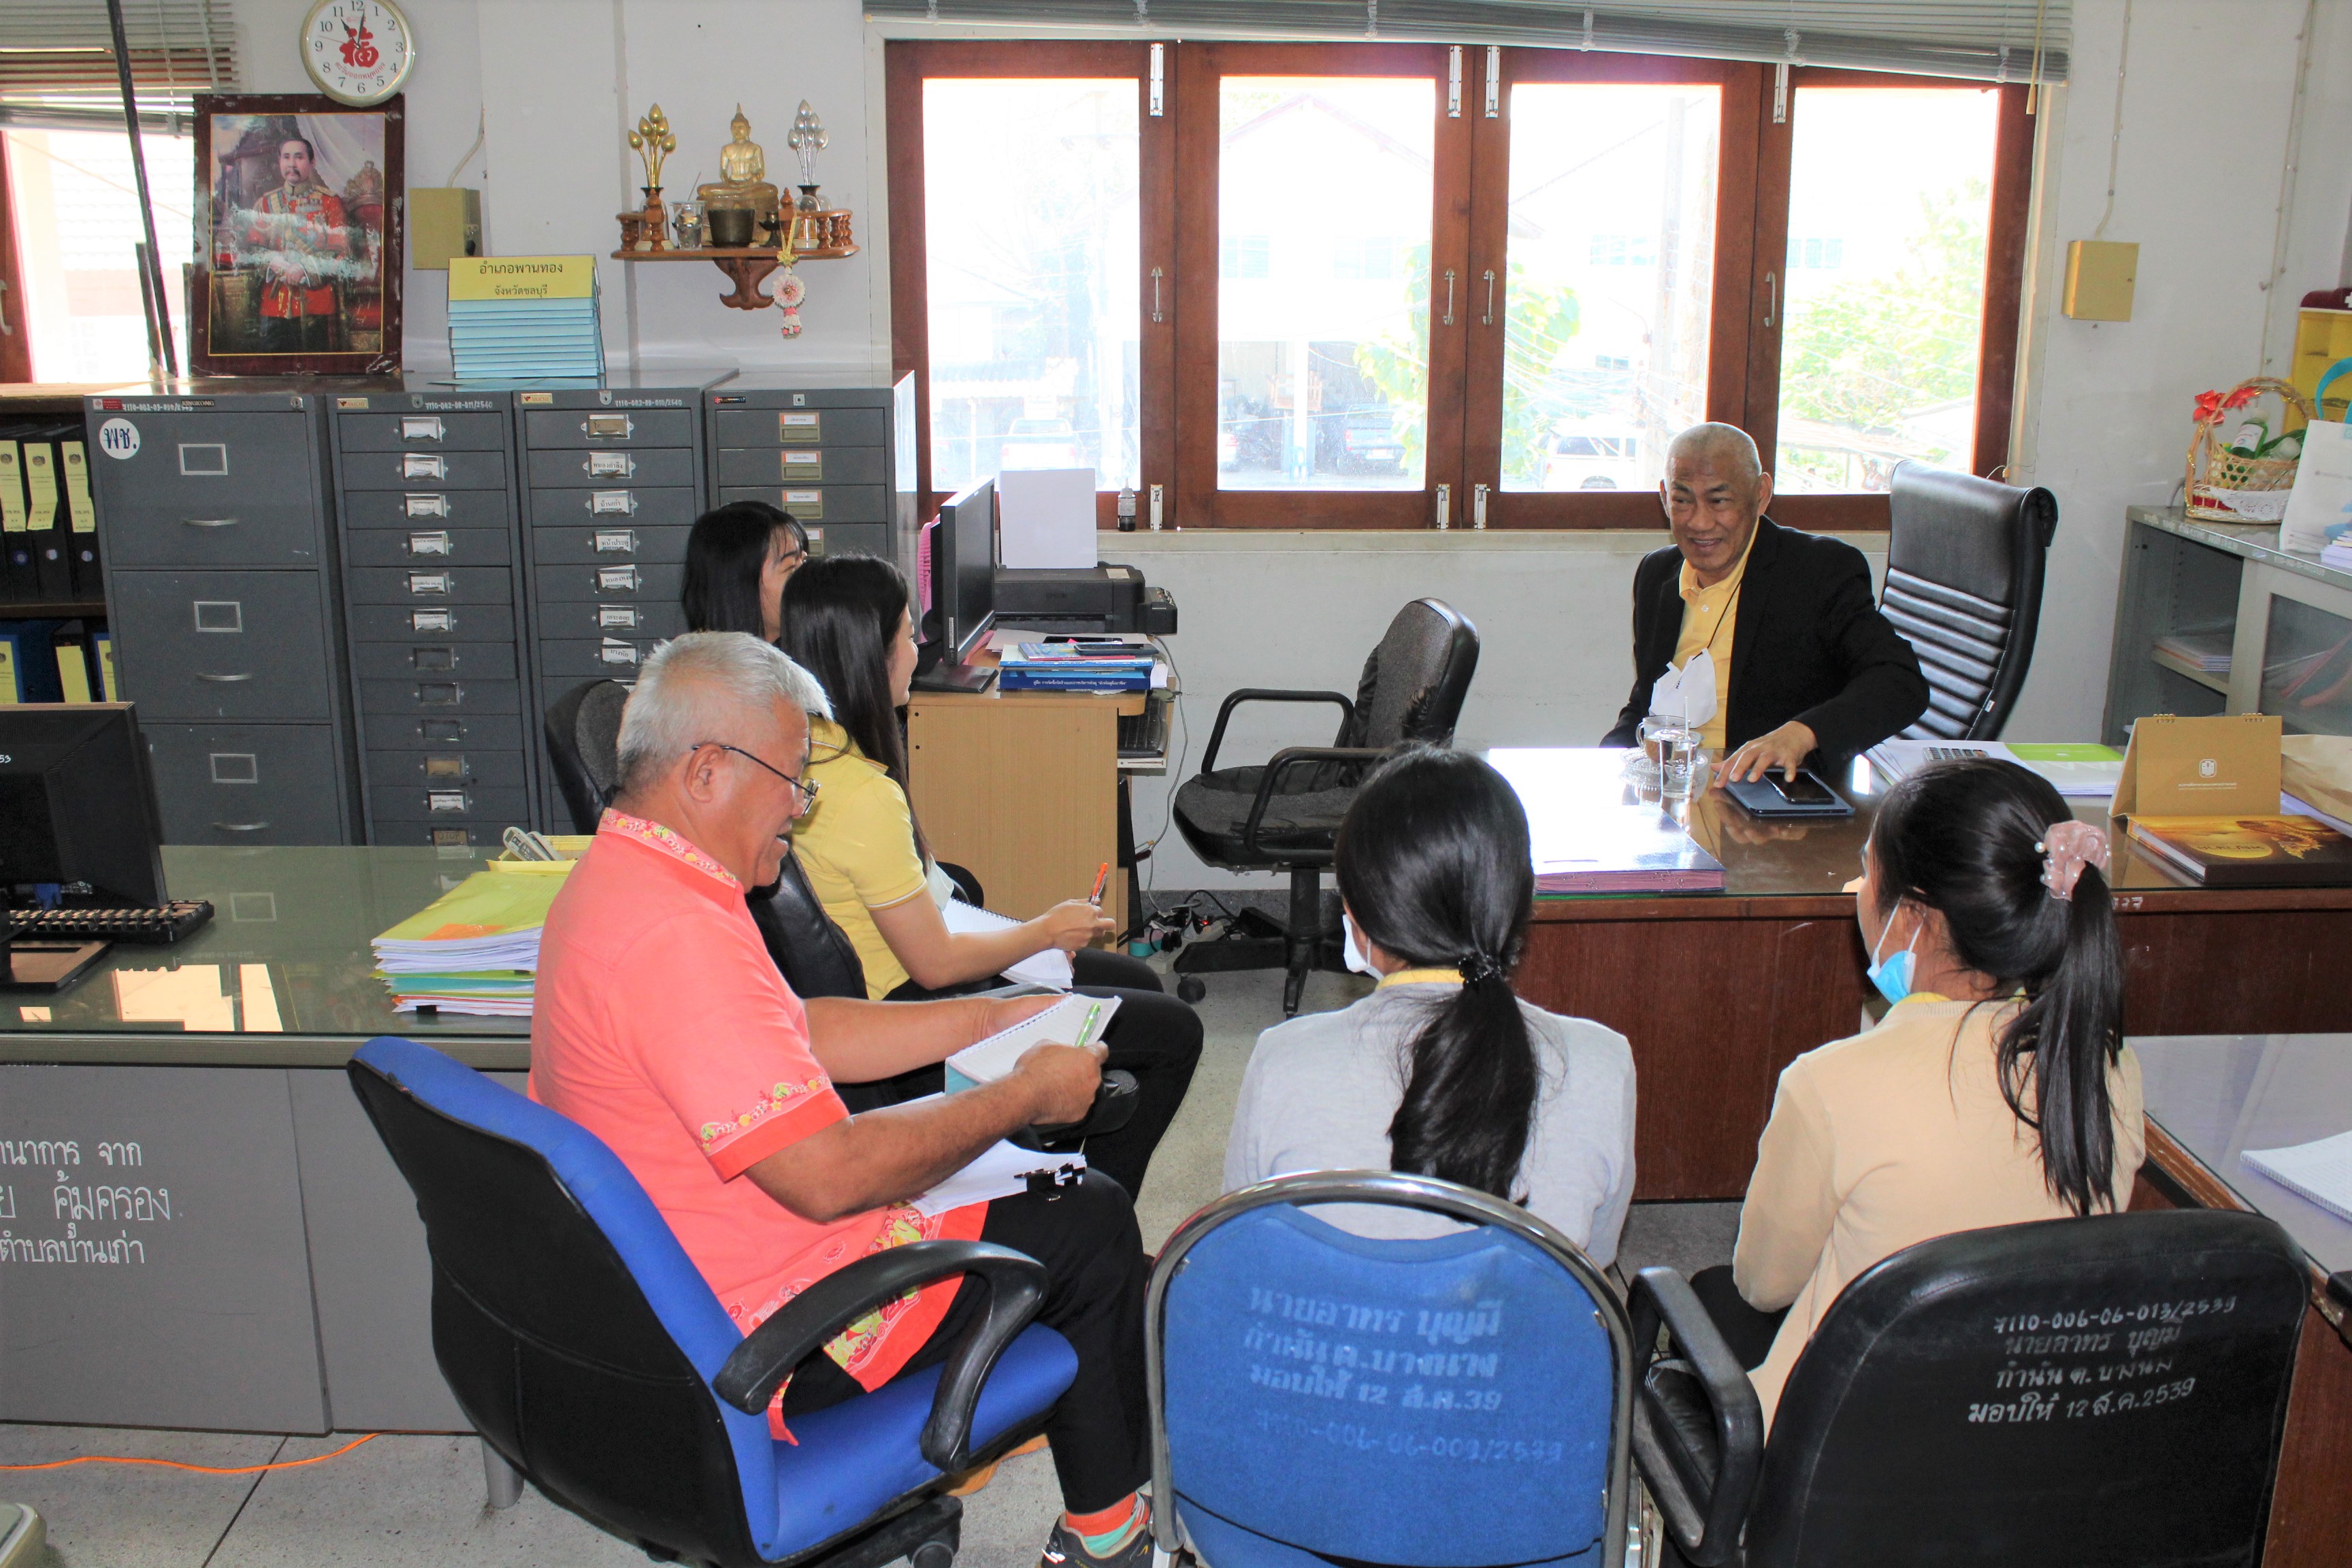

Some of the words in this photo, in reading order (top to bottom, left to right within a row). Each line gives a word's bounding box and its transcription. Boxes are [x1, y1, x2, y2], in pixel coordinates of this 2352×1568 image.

[333, 6, 344, 17] 11
[352, 1, 364, 11] 12
[375, 6, 379, 16] 1
[321, 21, 333, 32] 10
[387, 20, 395, 31] 2
[315, 41, 323, 52] 9
[395, 42, 404, 52] 3
[323, 62, 331, 74] 8
[390, 63, 397, 73] 4
[338, 77, 346, 87] 7
[376, 76, 385, 86] 5
[357, 82, 365, 93] 6
[480, 261, 563, 274] อำเภอพานทอง
[495, 284, 548, 297] จังหวัดชลบุรี
[99, 1142, 142, 1166] จาก
[2066, 1399, 2089, 1419] 12
